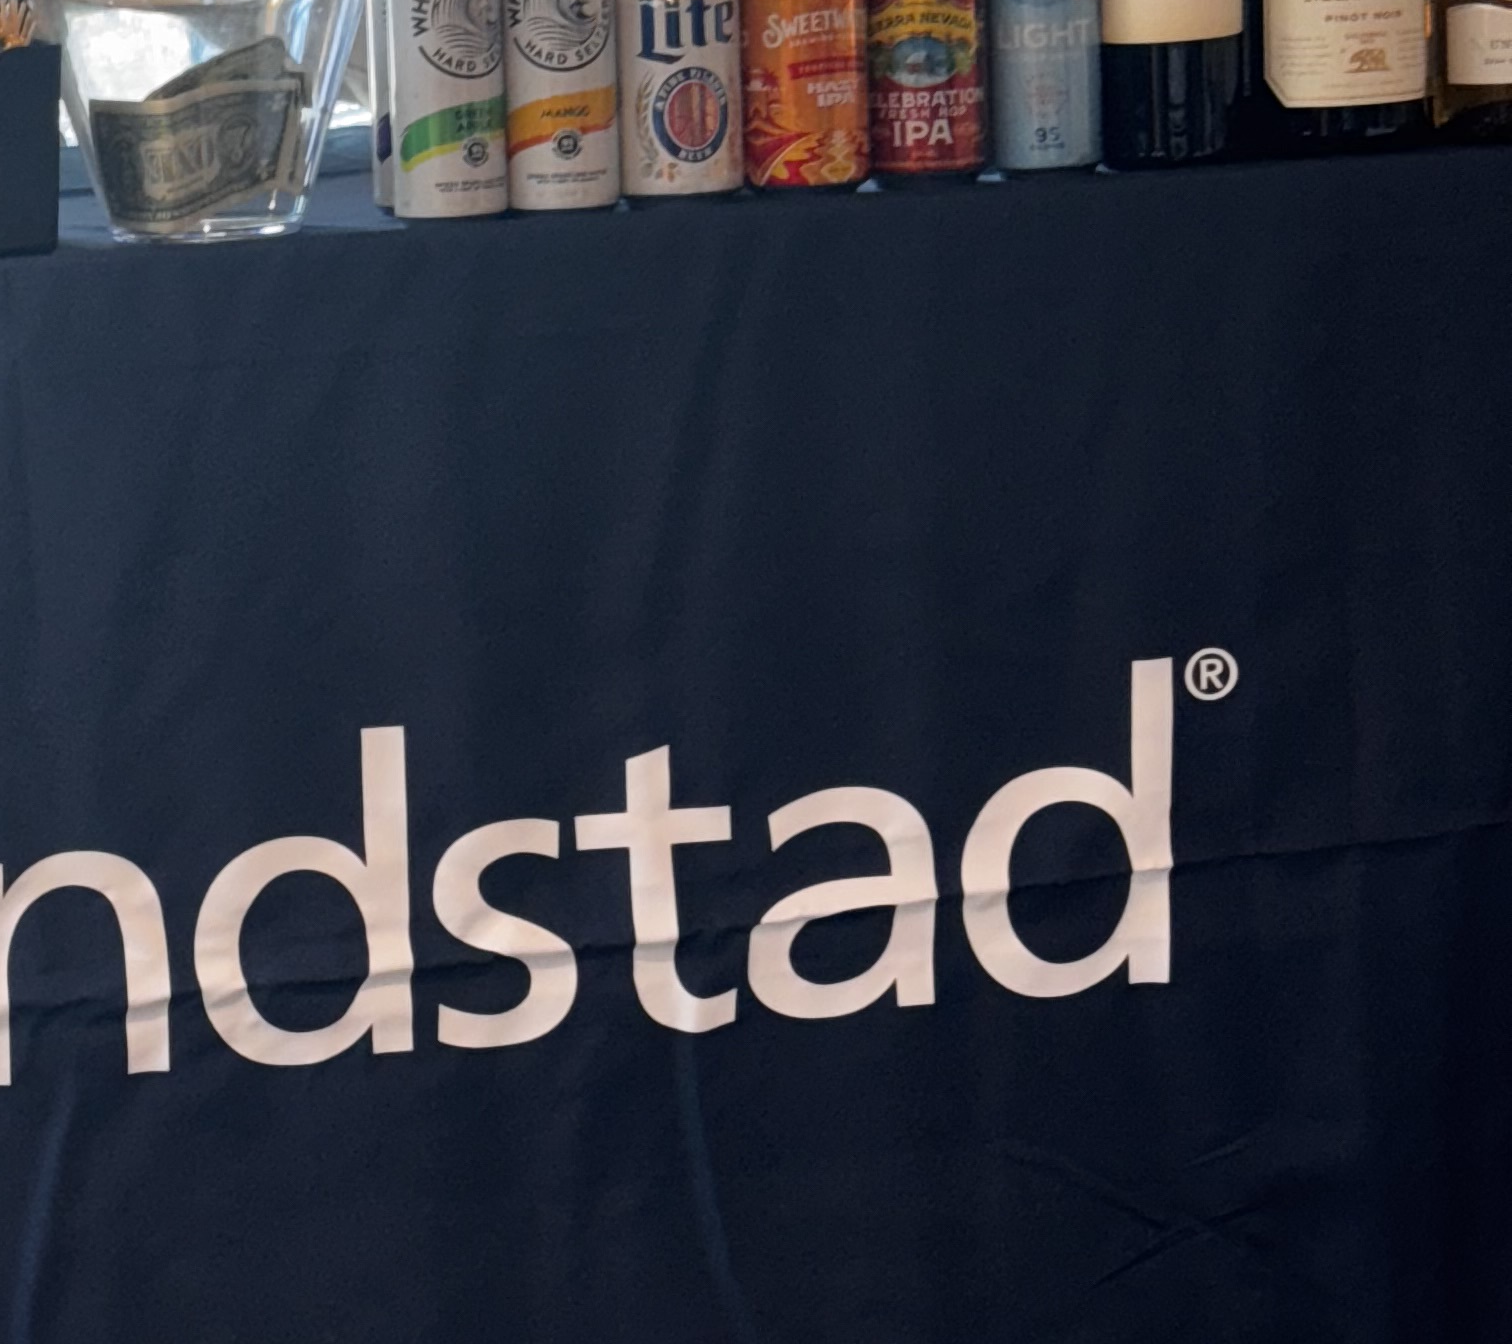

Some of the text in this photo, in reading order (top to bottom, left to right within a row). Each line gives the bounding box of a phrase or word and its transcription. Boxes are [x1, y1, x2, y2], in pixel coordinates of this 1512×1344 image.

[1325, 12, 1369, 23] PINOT
[998, 19, 1090, 50] LIGHT
[432, 48, 478, 73] HARD
[524, 39, 568, 65] HARD
[892, 118, 953, 147] IPA
